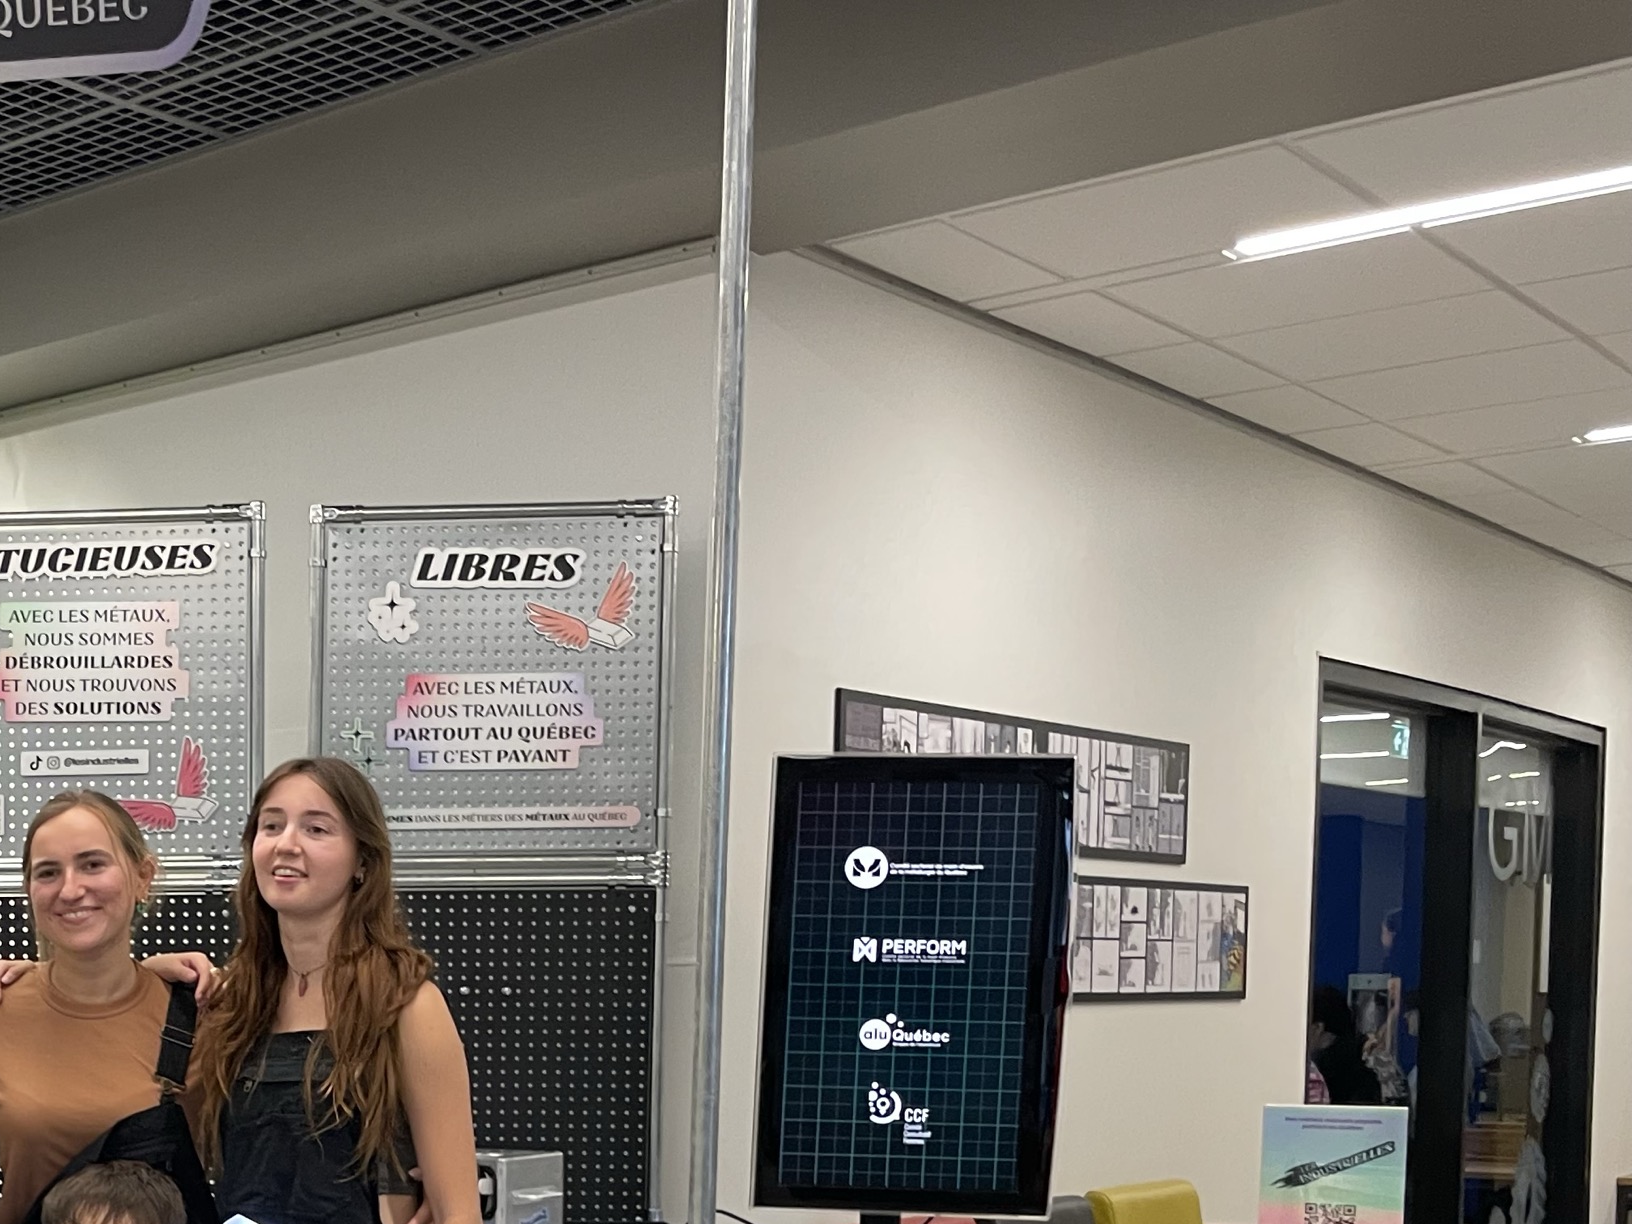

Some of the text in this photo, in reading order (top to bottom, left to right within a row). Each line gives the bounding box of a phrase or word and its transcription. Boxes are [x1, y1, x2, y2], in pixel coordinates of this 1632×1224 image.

[416, 552, 580, 582] LIBRES
[8, 609, 54, 624] AVEC
[58, 609, 89, 623] LES
[24, 632, 154, 647] NOUS SOMMES
[5, 652, 174, 670] DÉBROUILLARDES
[1, 678, 177, 692] ET NOUS TROUVONS
[413, 682, 459, 696] AVEC
[463, 682, 495, 695] LES
[15, 701, 162, 716] DES SOLUTIONS
[407, 703, 584, 719] NOUS TRAVAILLONS
[393, 723, 596, 743] PARTOUT AU QUÉBEC
[418, 749, 570, 765] ET C'EST PAYANT
[525, 811, 570, 821] MÉTAUX
[882, 938, 967, 955] PERFORM
[904, 1108, 930, 1122] CCF
